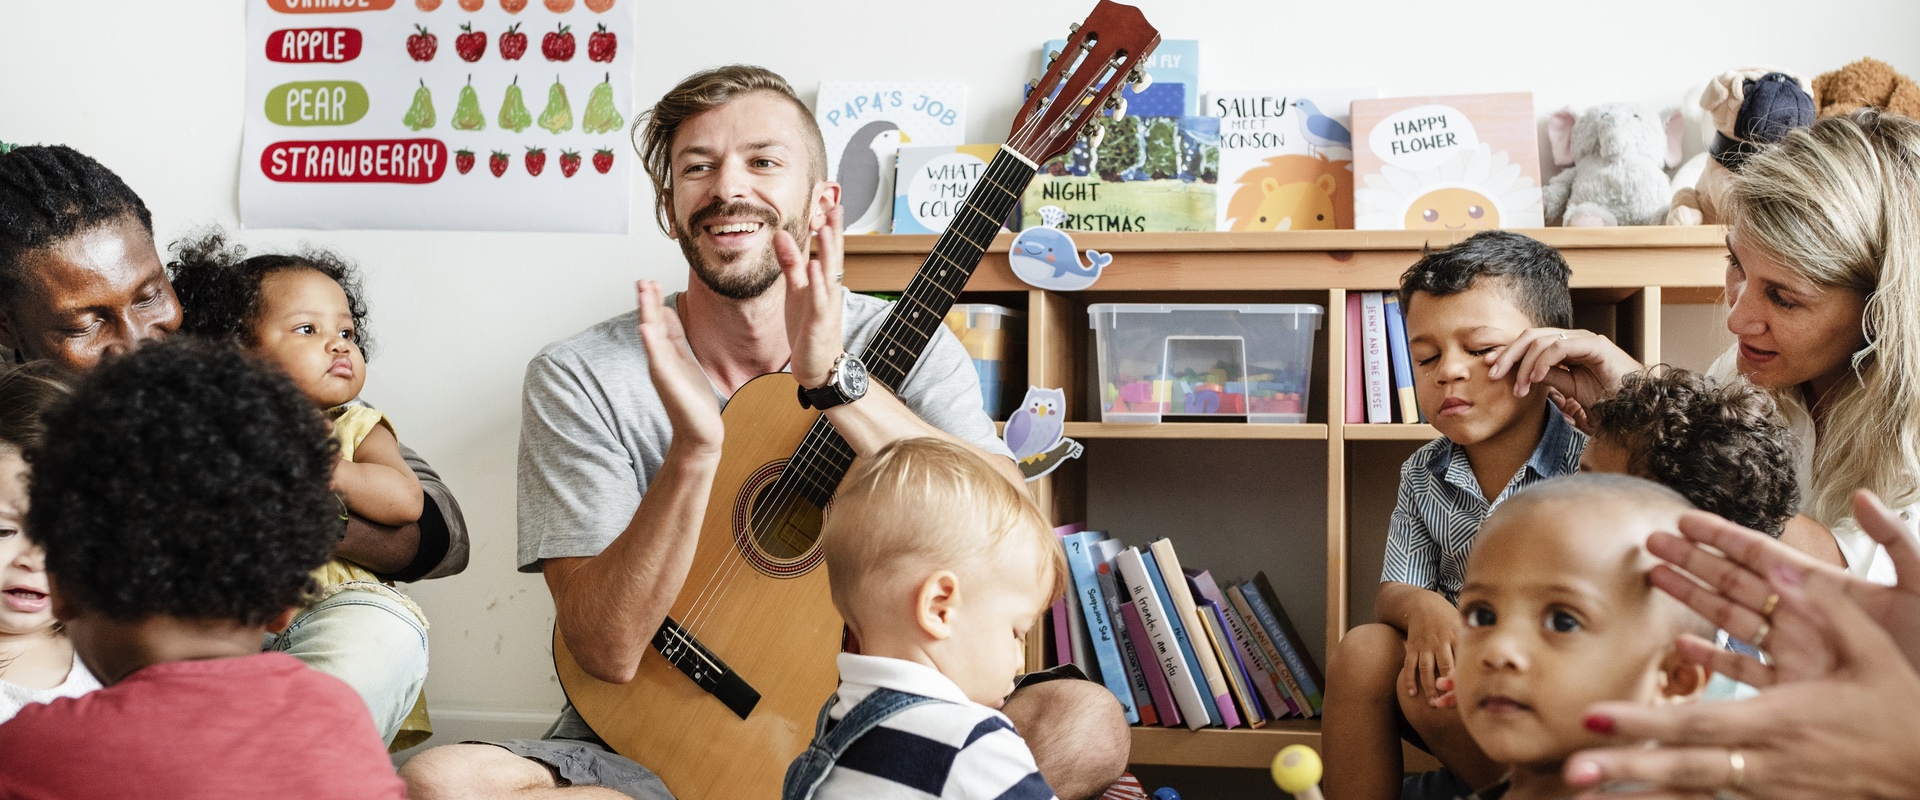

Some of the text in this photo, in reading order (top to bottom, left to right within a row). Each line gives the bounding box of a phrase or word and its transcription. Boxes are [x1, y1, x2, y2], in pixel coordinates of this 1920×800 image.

[281, 30, 345, 61] APPLE
[1161, 54, 1182, 69] FLY
[286, 87, 347, 122] PEAR
[826, 90, 957, 127] PAPA'S JOB
[1217, 96, 1286, 118] SALLEY
[1232, 119, 1266, 130] MEET
[1394, 115, 1447, 136] HAPPY
[1220, 132, 1285, 149] KONSON
[1391, 132, 1458, 155] FLOWER
[271, 143, 438, 178] STRAWBERRY
[927, 163, 982, 180] WHAT
[941, 182, 968, 198] MY
[1043, 181, 1100, 201] NIGHT
[1041, 214, 1146, 232] RISTMAS
[1366, 305, 1382, 408] JENNY AND THE HORSE
[1072, 541, 1081, 554] ?
[1134, 585, 1145, 595] Hi
[1157, 641, 1167, 655] am
[1164, 657, 1178, 676] tofu
[1222, 608, 1263, 671] Friendly Monster
[1251, 622, 1269, 647] PLANT
[1268, 647, 1283, 667] LIFE
[1281, 668, 1299, 693] CYCLE
